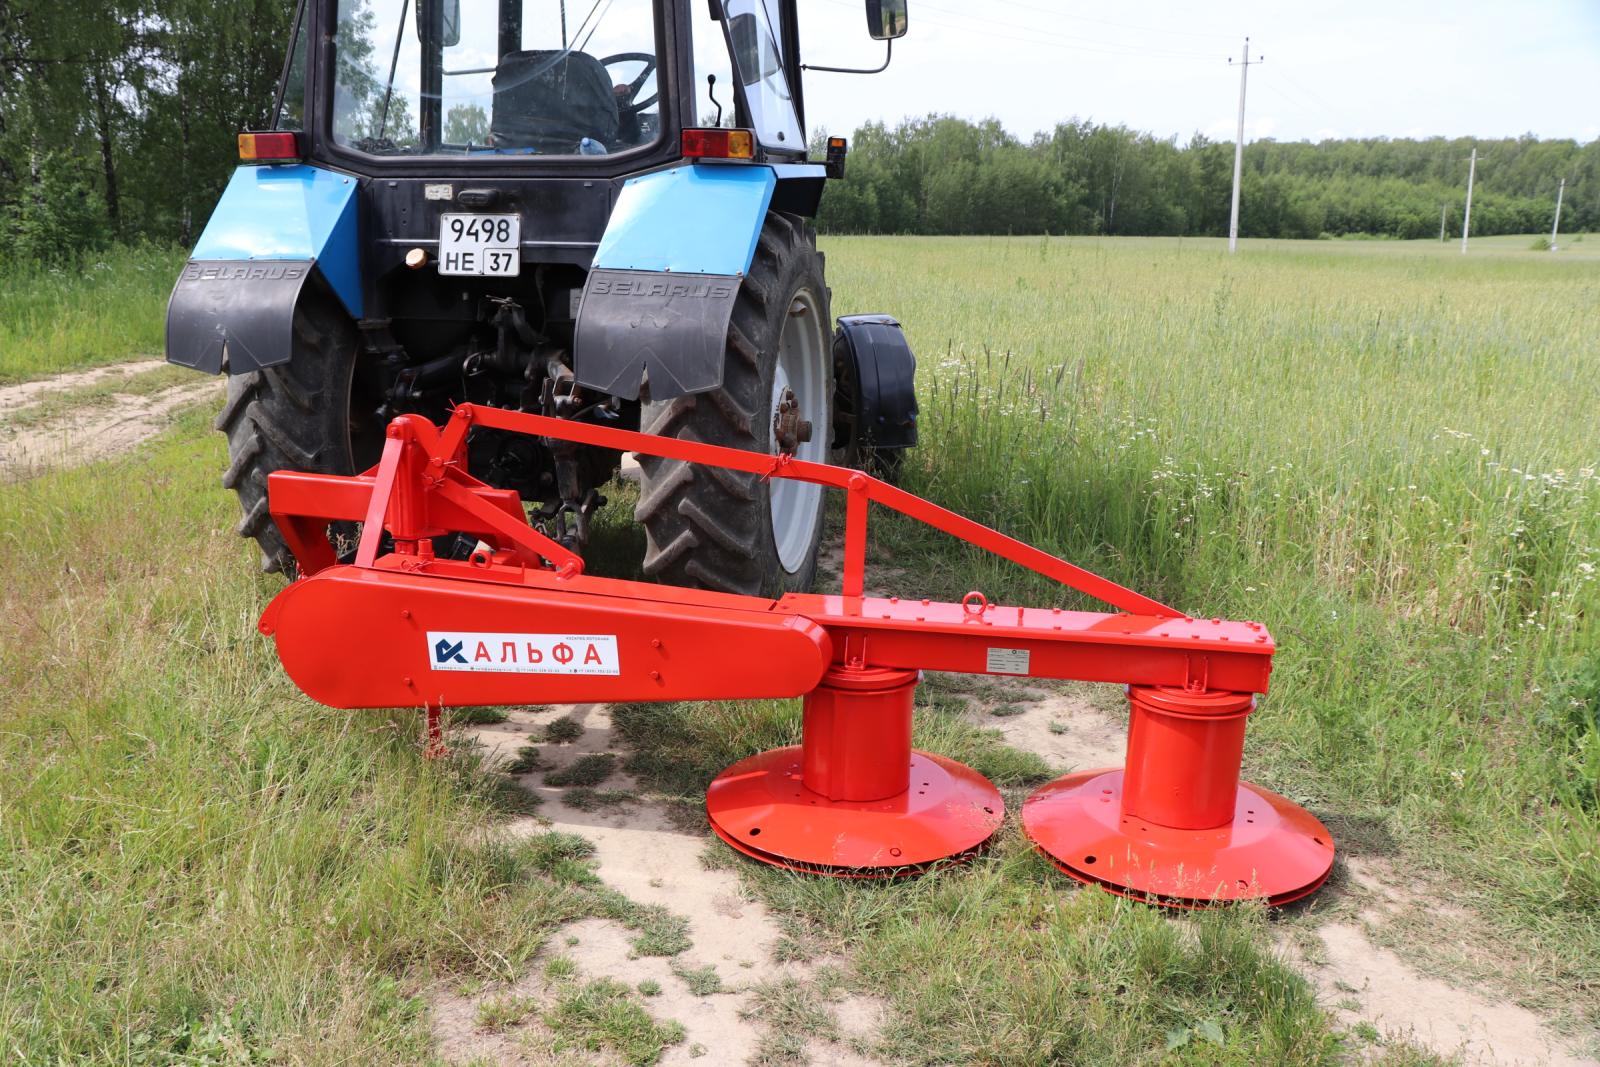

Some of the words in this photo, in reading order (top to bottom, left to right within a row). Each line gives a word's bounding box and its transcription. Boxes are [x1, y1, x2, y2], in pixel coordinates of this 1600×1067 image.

[451, 218, 510, 243] 9498
[182, 261, 304, 281] BELARUS
[489, 252, 513, 272] 37
[591, 279, 731, 299] BELARUS
[474, 640, 603, 665] АЛЬФА
